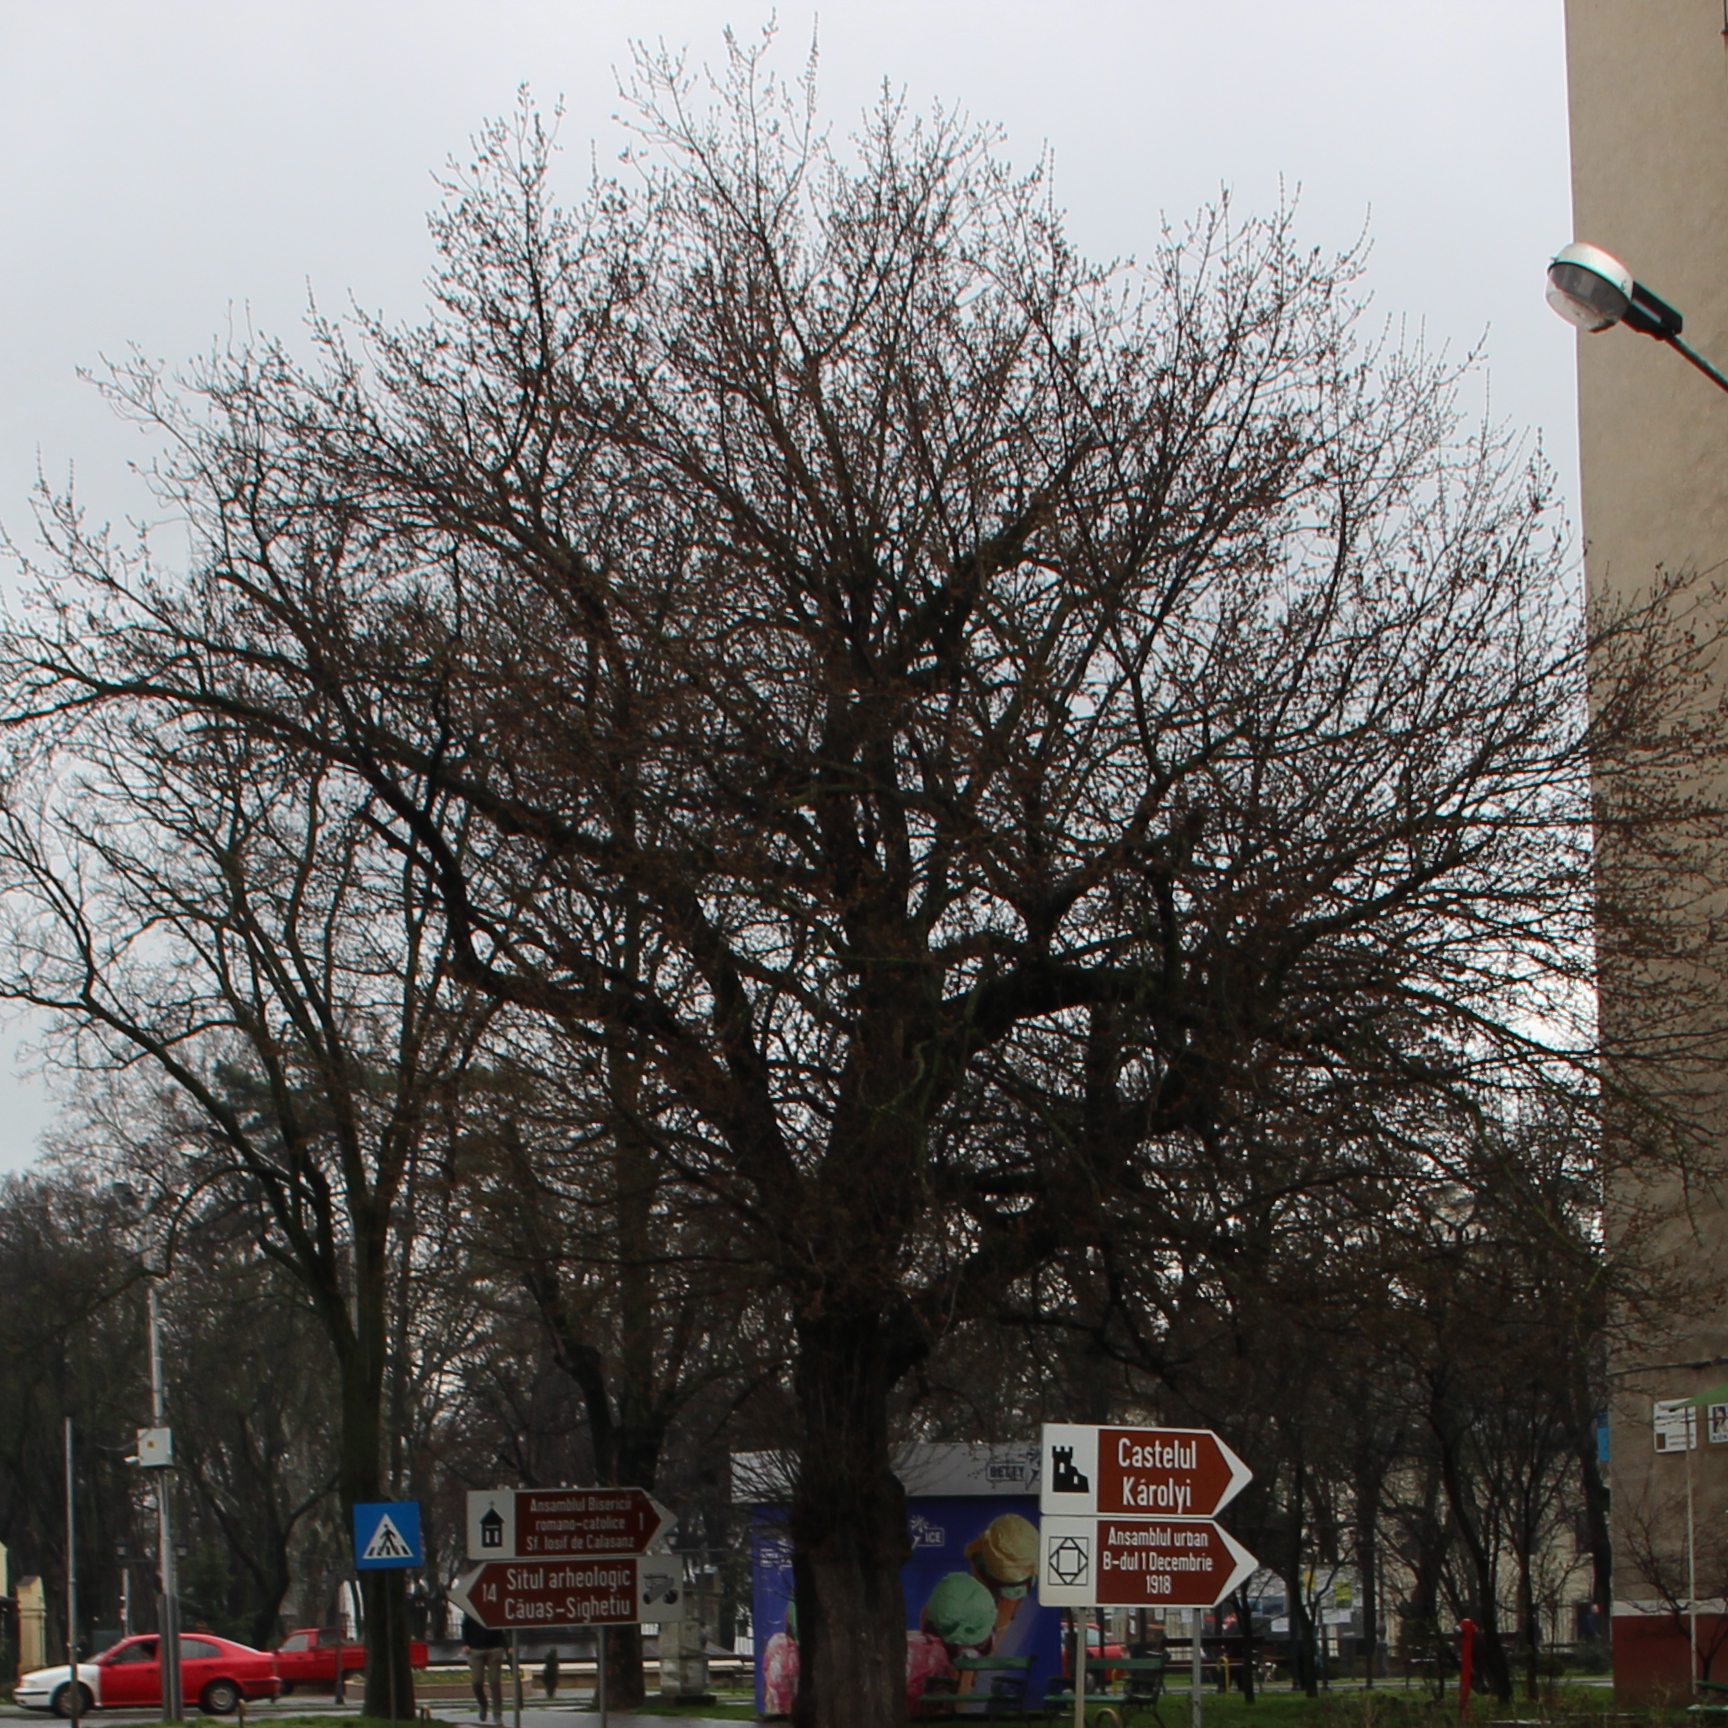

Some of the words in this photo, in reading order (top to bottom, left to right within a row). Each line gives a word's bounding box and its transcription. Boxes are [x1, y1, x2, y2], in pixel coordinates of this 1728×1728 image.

[1118, 1437, 1197, 1469] Castelul
[530, 1496, 585, 1513] Ansamblul
[588, 1495, 632, 1511] Bisericii
[1122, 1476, 1192, 1514] Károlyi
[535, 1516, 625, 1532] romano-catolice
[544, 1536, 568, 1550] Iosif
[571, 1535, 583, 1549] de
[586, 1534, 635, 1549] Calasanz
[925, 1533, 942, 1543] ICE
[1108, 1527, 1171, 1546] Ansamblul
[1174, 1531, 1208, 1547] urban
[1103, 1551, 1138, 1571] B-dul
[1141, 1553, 1146, 1571] 1
[1149, 1552, 1214, 1571] Decembrie
[506, 1568, 544, 1590] Situl
[548, 1565, 631, 1592] arheologic
[1146, 1575, 1172, 1594] 1918
[482, 1583, 497, 1603] 14
